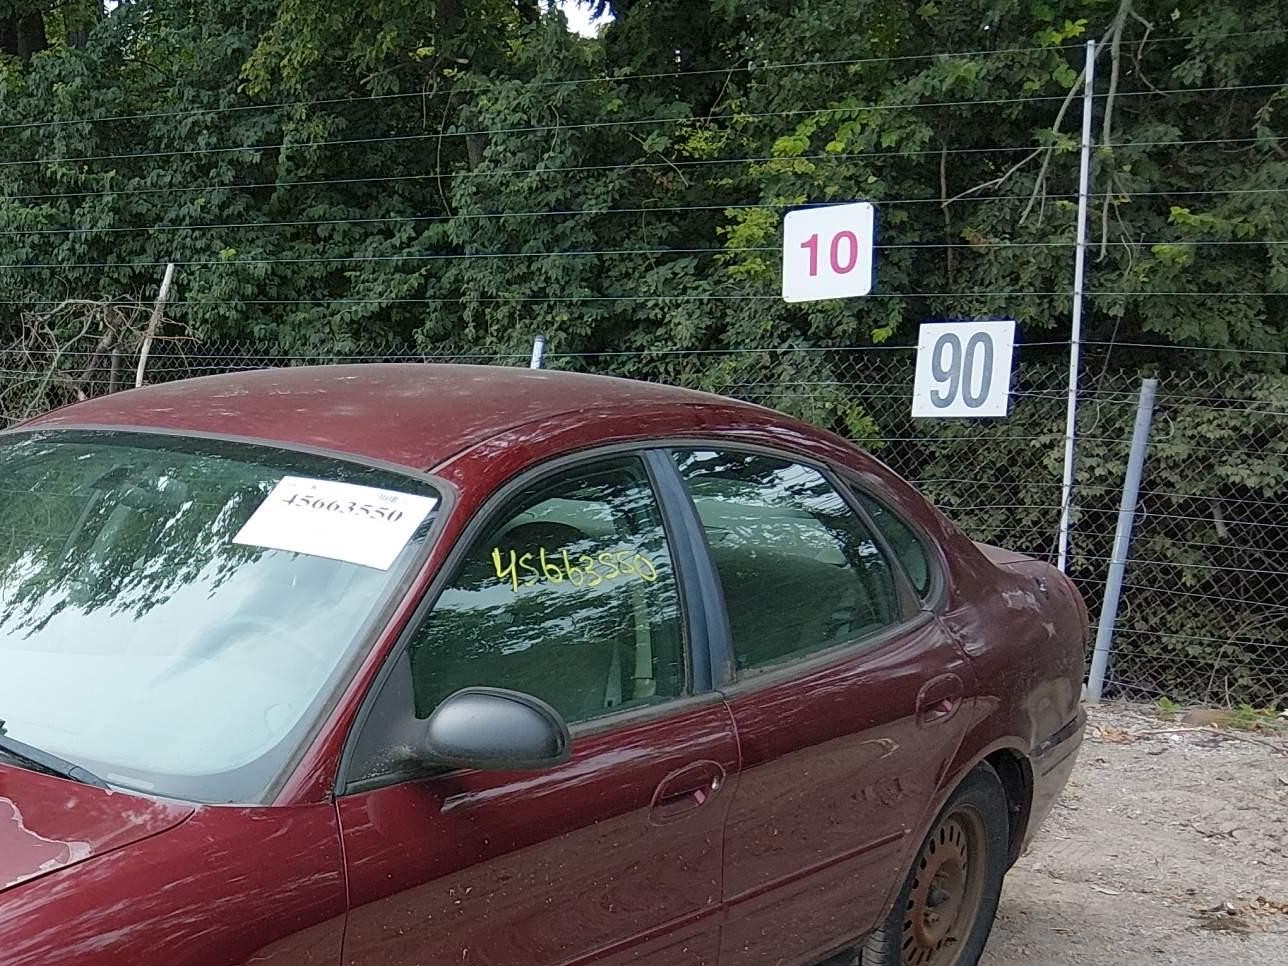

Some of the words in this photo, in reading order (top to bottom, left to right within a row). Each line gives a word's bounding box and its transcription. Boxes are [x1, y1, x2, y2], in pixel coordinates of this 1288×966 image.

[800, 230, 859, 277] 10
[929, 331, 994, 409] 90
[281, 494, 404, 522] 45663550
[491, 547, 657, 592] 45663550
